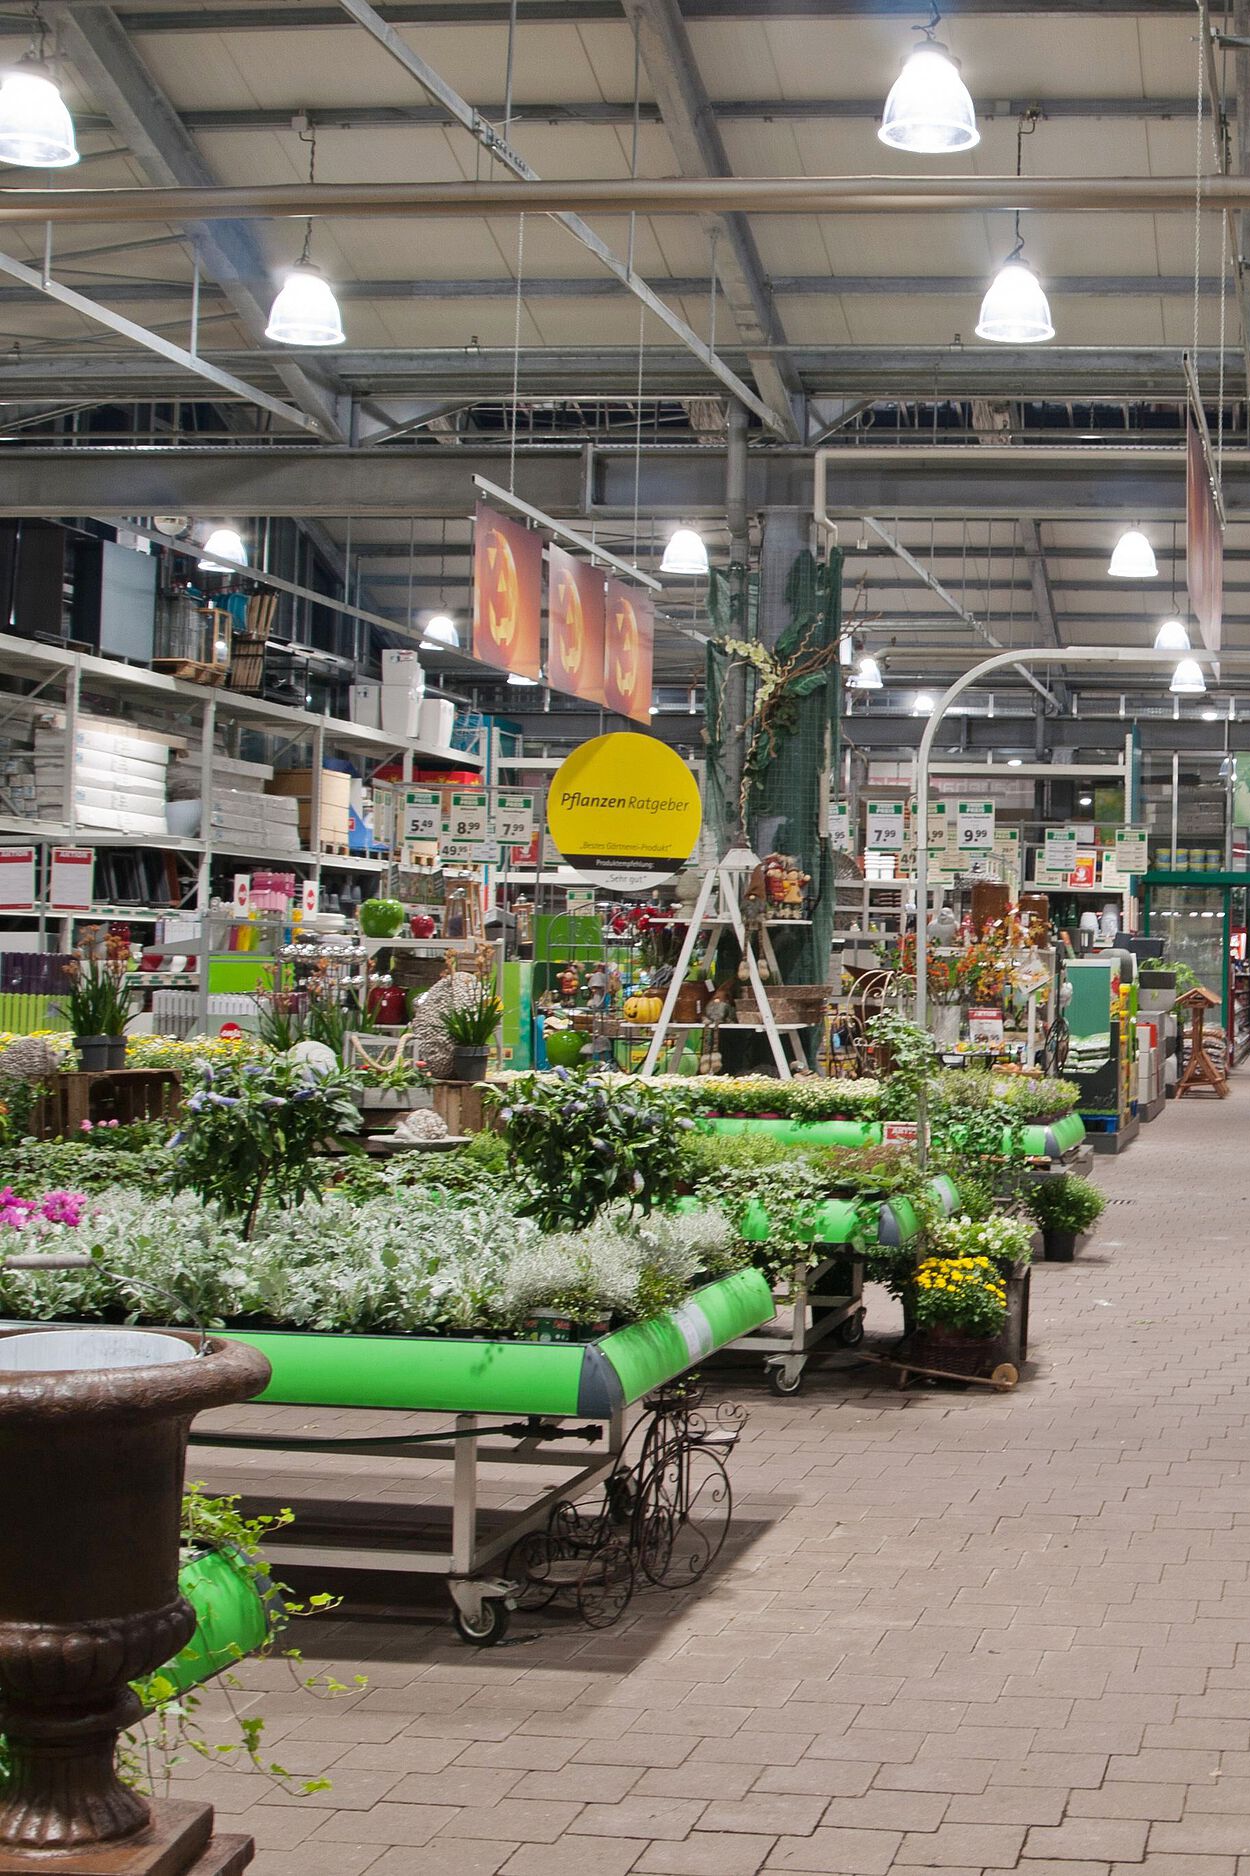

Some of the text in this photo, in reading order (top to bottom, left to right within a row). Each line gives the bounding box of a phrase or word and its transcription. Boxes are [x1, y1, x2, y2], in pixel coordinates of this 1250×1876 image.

[560, 792, 690, 815] Pflanzen Ratgeber
[411, 819, 434, 832] 5.49
[457, 821, 481, 835] 8.99
[502, 823, 525, 836] 7.99
[874, 829, 896, 842] 7.99
[964, 829, 988, 842] 9.99
